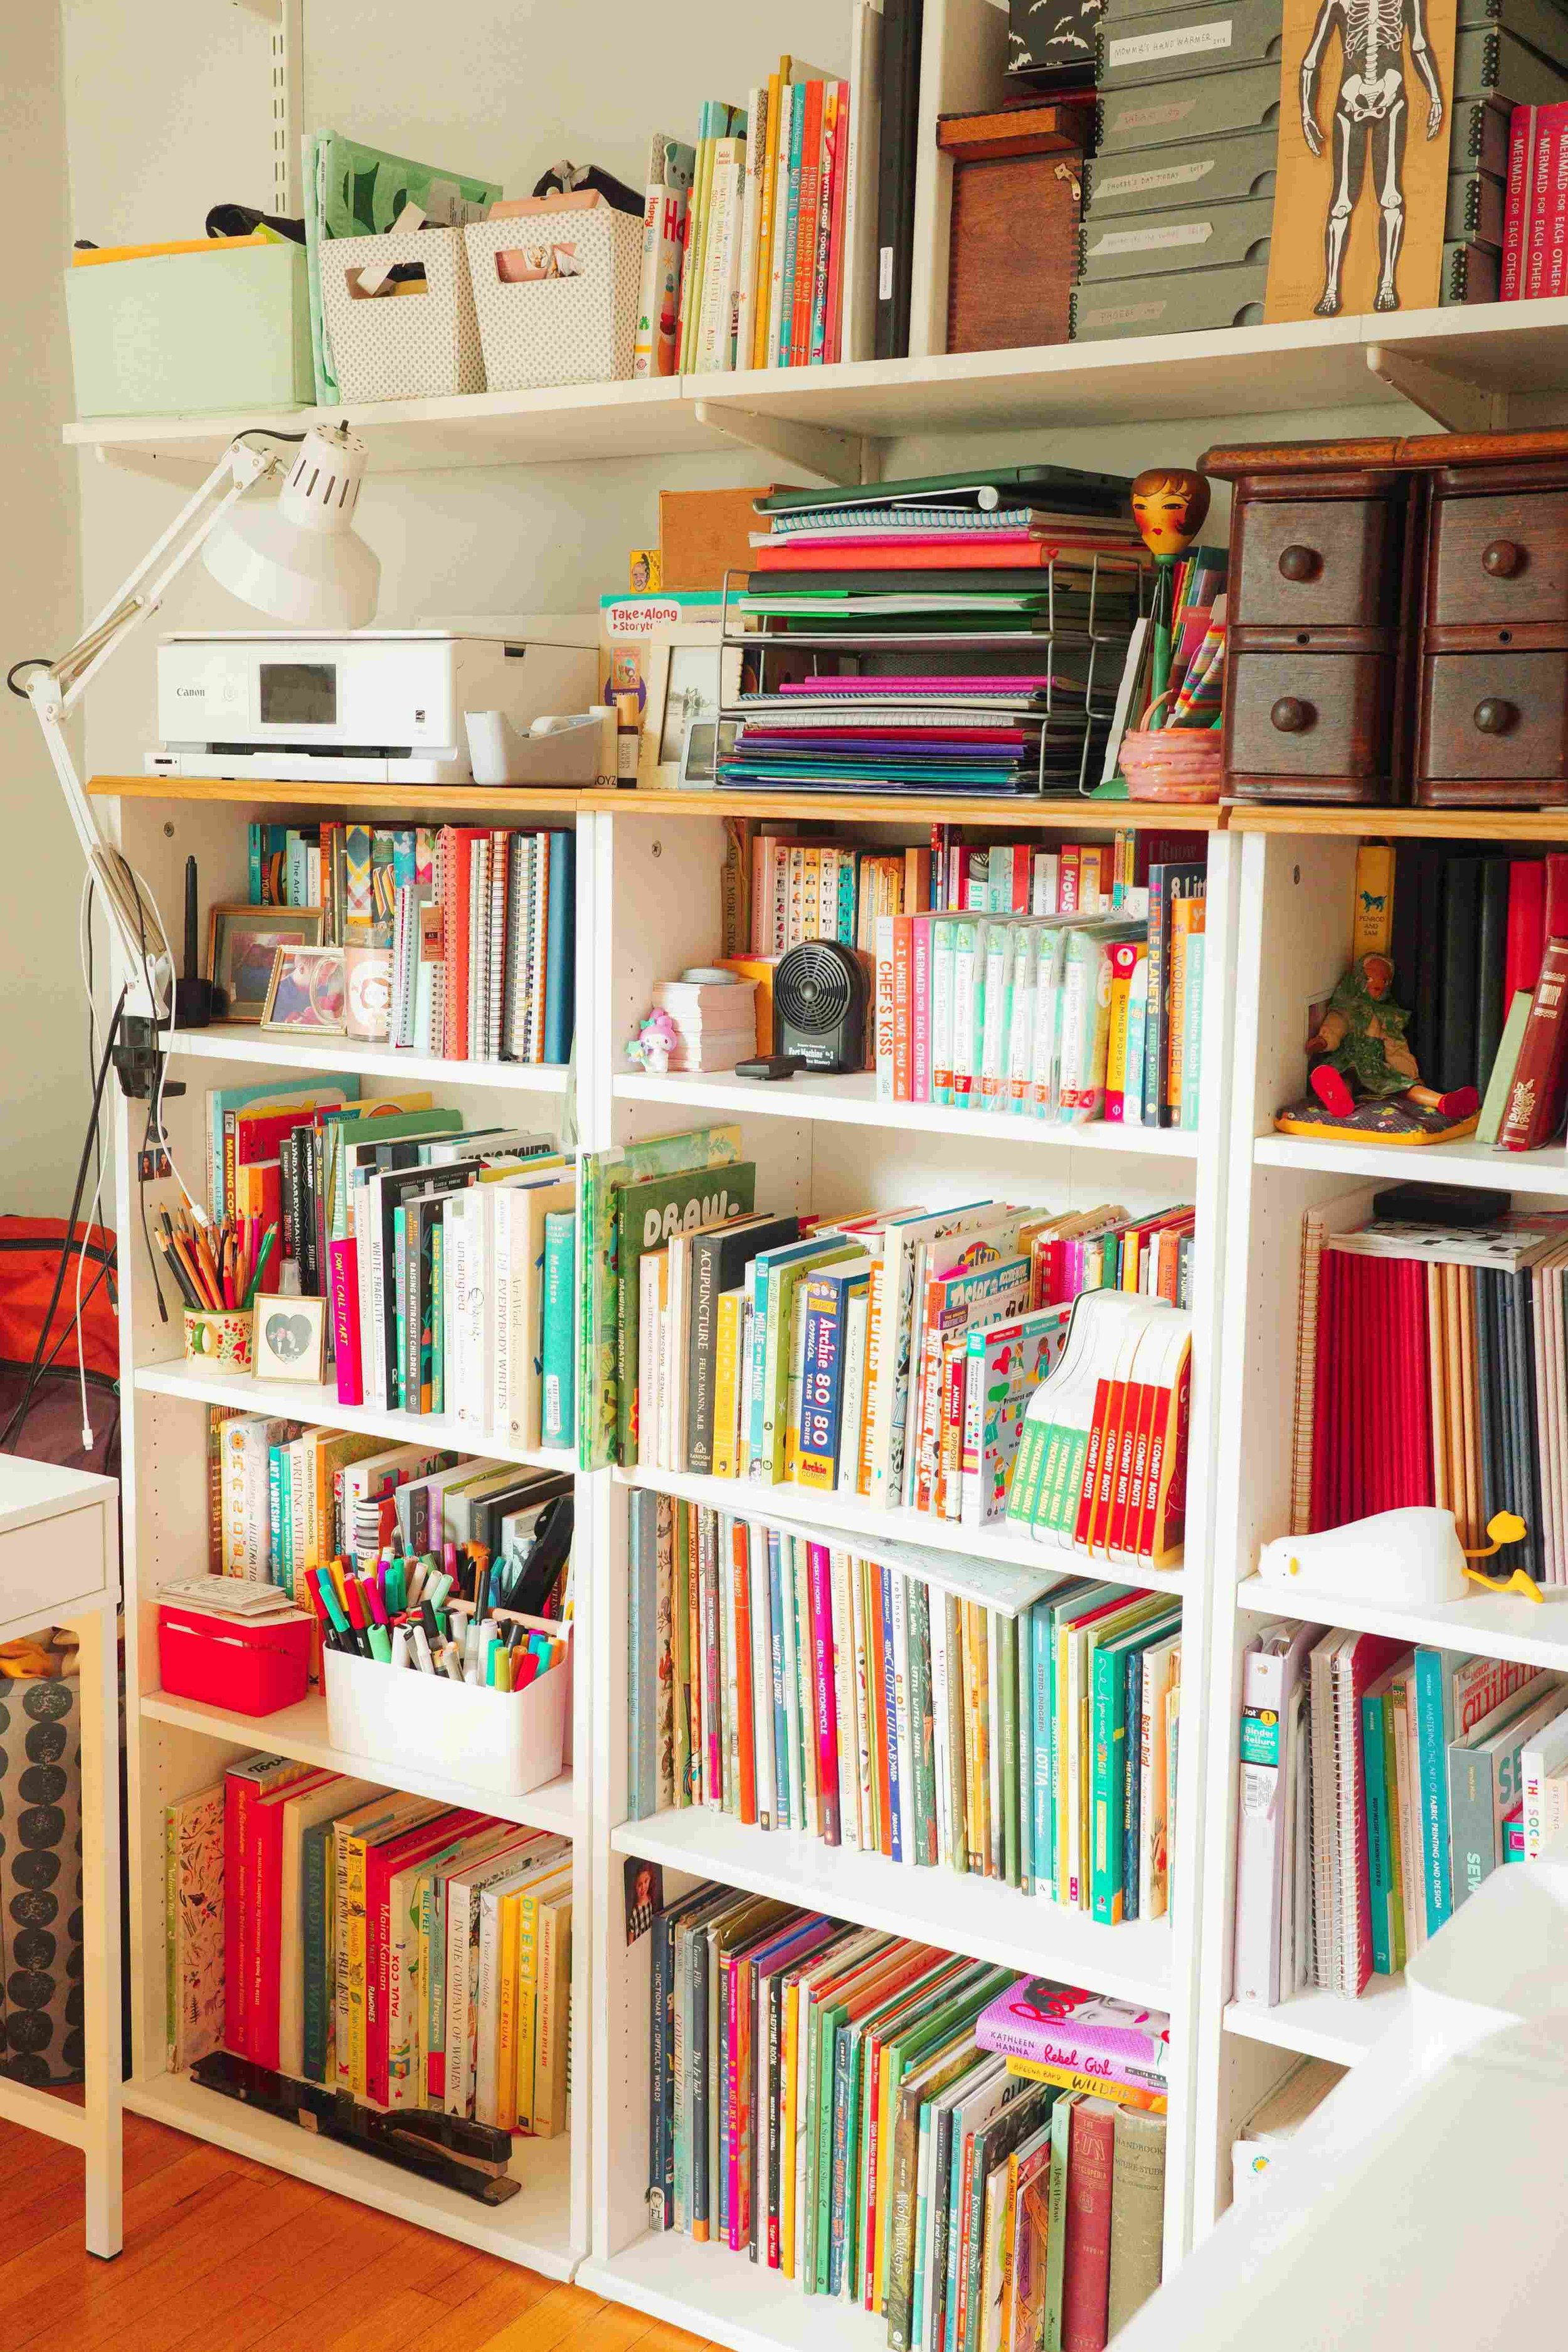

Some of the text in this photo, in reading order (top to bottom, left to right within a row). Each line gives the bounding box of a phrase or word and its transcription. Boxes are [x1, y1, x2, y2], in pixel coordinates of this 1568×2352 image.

[1153, 33, 1211, 51] HAND WARMER
[645, 197, 659, 228] Happy
[1505, 139, 1524, 290] MERMAID FOR EACH OTHER
[1530, 137, 1551, 290] MERMAID FOR EACH OTHER
[1551, 134, 1568, 287] MERMAID FOR EACH OTHER
[784, 216, 798, 277] TOMORROW
[803, 216, 814, 277] SOUNDS IT
[816, 175, 830, 327] WITH FOOD TODDLER COOKBOOK
[176, 687, 206, 697] Canon
[726, 887, 736, 922] MORE
[1171, 877, 1181, 899] 8
[1359, 914, 1385, 923] PENROD
[879, 960, 893, 1014] CHEF'S
[916, 946, 925, 1076] MERMAID EACH OTHER
[1148, 950, 1160, 1014] PLANETS
[896, 961, 908, 1067] WHEELIE YOU
[1116, 994, 1126, 1061] SUMMER POPS
[1171, 953, 1184, 1077] WORLD MEET
[800, 1048, 823, 1058] Machine
[226, 1139, 235, 1189] MAKING
[334, 1253, 349, 1346] DON'T CALL IT ART
[373, 1242, 384, 1324] WHITE FRAGILITY
[697, 1249, 711, 1350] ACUPUNCTURE
[409, 1295, 417, 1338] ANTIRACIST
[497, 1278, 507, 1409] EVERYBODY WRITES
[408, 1339, 417, 1378] CHILDREN
[699, 1357, 707, 1382] FELIX
[813, 1316, 836, 1449] Archie 80 80
[803, 1372, 813, 1446] YEARS STORIES
[951, 1384, 961, 1419] ANIMAL
[270, 1459, 280, 1534] ART WORKSHOP
[1083, 1434, 1099, 1498] COWBOY BOOTS
[1100, 1437, 1116, 1502] COWBOY BOOTS
[1117, 1438, 1132, 1505] COWBOY BOOTS
[1131, 1441, 1146, 1507] COWBOY BOOTS
[1147, 1443, 1162, 1510] COWBOY BOOTS
[283, 1493, 292, 1559] drawing workshop
[292, 1455, 305, 1554] WRITING WITH
[690, 1568, 697, 1577] TO
[772, 1634, 783, 1705] WHAT IS LOVE?
[819, 1677, 828, 1735] MOTORCYCLE
[1244, 1726, 1274, 1738] Binder
[1265, 1712, 1271, 1721] 1
[1427, 1703, 1436, 1747] MASTERING
[1140, 1714, 1150, 1767] Bear Bird
[1430, 1796, 1438, 1821] FABRIC
[1551, 1786, 1560, 1831] GETTING
[1431, 1824, 1440, 1861] PRINTING
[379, 1902, 389, 1991] Maira Kalman
[521, 1899, 532, 1983] Olle Eksell
[367, 1984, 376, 2023] RAMONES
[391, 1954, 400, 2018] PAUL COX
[450, 1919, 464, 2092] IN THE COMPANY OF WOMEN
[501, 1979, 511, 2050] DICK BRUNA
[990, 2030, 1035, 2048] KATHLEEN
[995, 2042, 1029, 2057] HANNA
[1044, 2043, 1113, 2075] Rebel Girl
[1072, 2075, 1138, 2102] WILDFIRE
[1083, 2119, 1094, 2129] THE
[973, 2149, 982, 2180] Willems
[968, 2195, 981, 2277] KNUFFLE BUNNY
[1004, 2267, 1012, 2286] STOP
